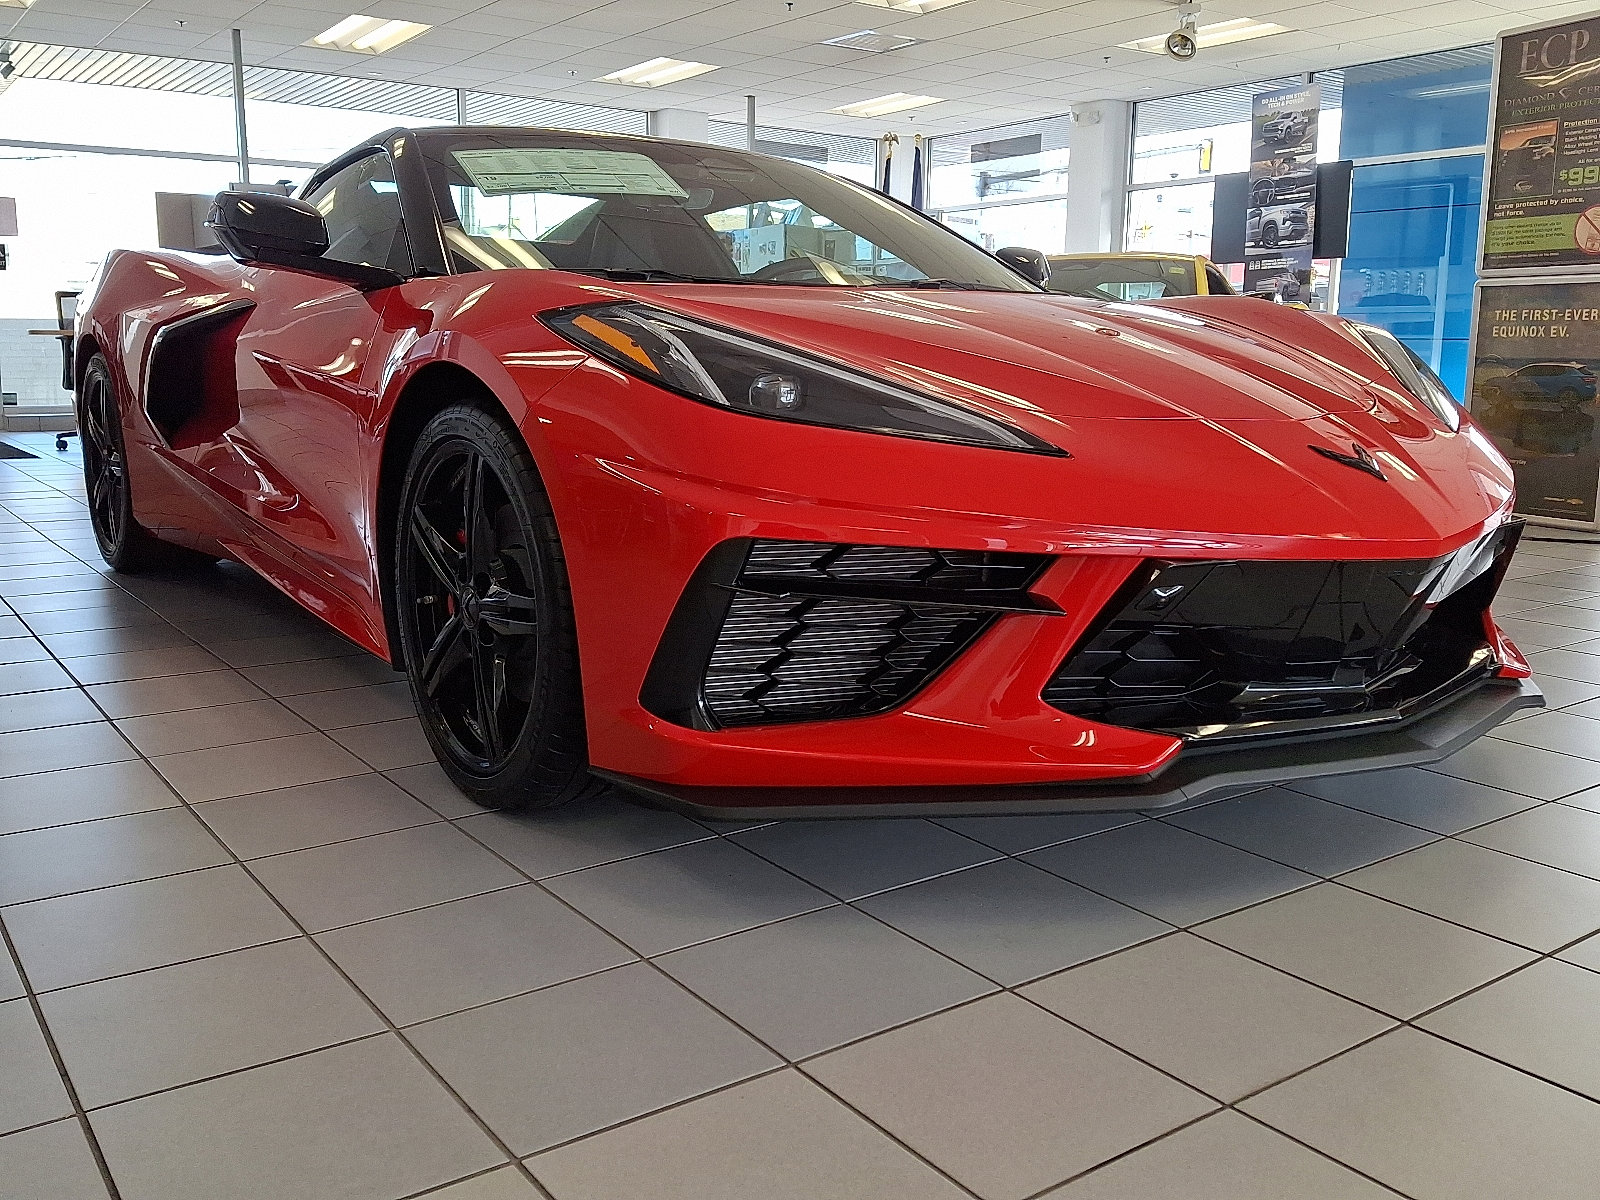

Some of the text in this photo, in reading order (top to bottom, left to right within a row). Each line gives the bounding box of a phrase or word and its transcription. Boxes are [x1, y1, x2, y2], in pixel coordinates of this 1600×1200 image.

[1519, 30, 1589, 74] ECP
[1505, 93, 1555, 106] DIAMOND
[1512, 104, 1556, 116] EXTERIOR
[1564, 118, 1598, 128] Protection
[1560, 166, 1600, 185] $99
[1495, 202, 1514, 210] Leave
[1516, 200, 1548, 208] protected
[1550, 198, 1559, 206] by
[1494, 308, 1599, 321] THE FIRST-EVER
[1492, 325, 1570, 338] EQUINOX EV.
